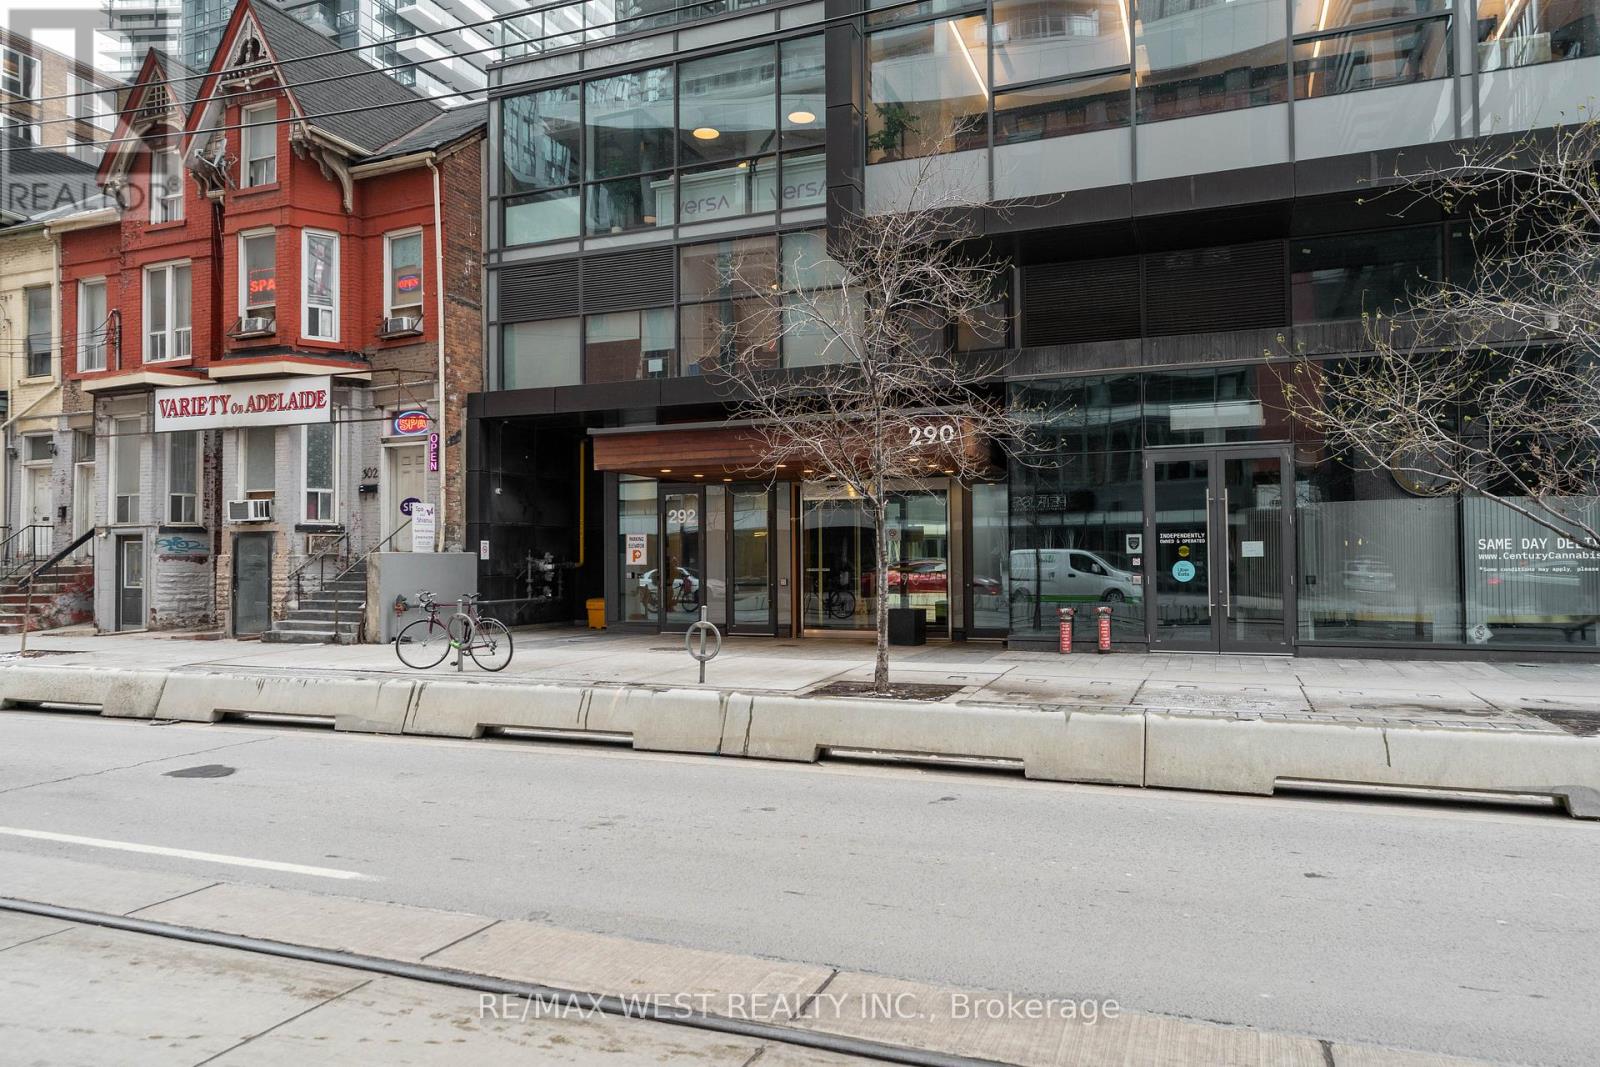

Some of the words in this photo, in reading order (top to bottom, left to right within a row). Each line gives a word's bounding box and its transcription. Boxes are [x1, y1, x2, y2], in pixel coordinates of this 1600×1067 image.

[250, 278, 276, 292] SPA
[159, 395, 231, 418] VARIETY
[231, 402, 243, 415] On
[245, 390, 327, 413] ADELAIDE
[400, 416, 426, 430] SPA
[909, 425, 954, 445] 290
[430, 433, 438, 470] OPEN
[362, 467, 378, 479] 302
[669, 509, 695, 523] 292
[1478, 538, 1512, 550] SAME
[1522, 538, 1547, 549] DAY
